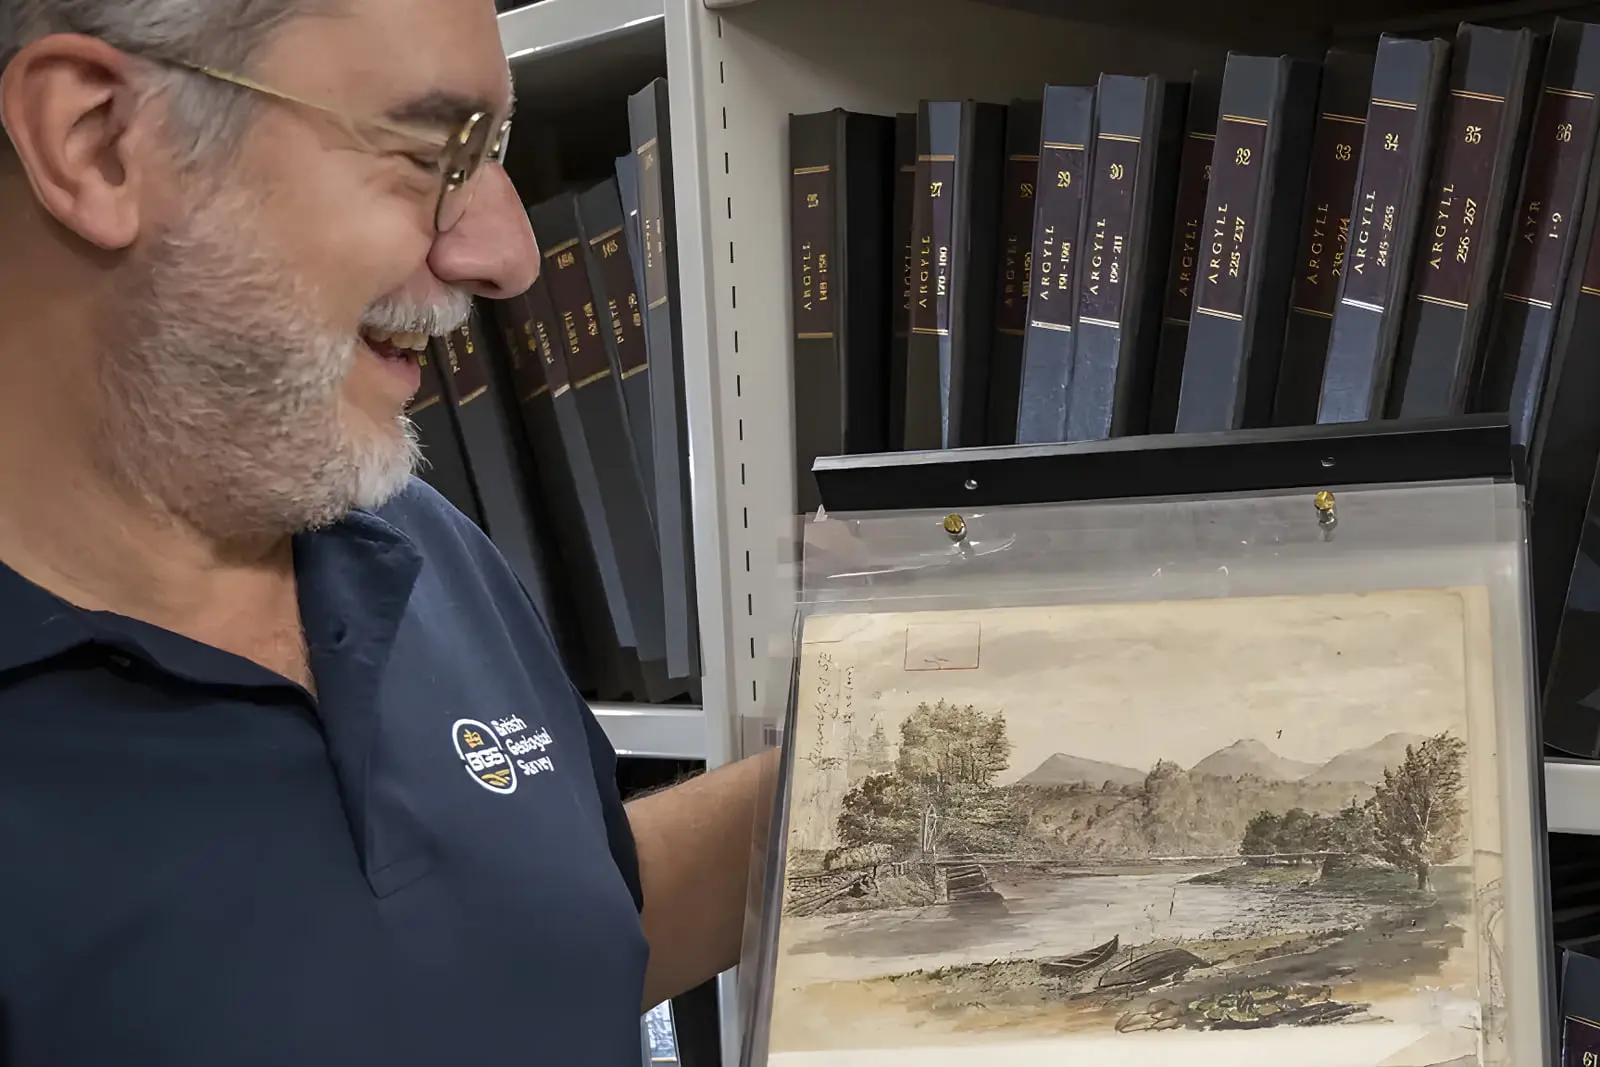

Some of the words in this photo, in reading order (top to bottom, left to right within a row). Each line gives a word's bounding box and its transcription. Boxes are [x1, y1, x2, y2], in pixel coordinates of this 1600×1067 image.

[1236, 147, 1251, 165] 32
[1335, 144, 1351, 161] 33
[1384, 133, 1399, 151] 34
[1464, 125, 1482, 144] 35
[1556, 123, 1572, 142] 36
[1090, 218, 1106, 295] ARGYLL
[1208, 203, 1228, 284] ARGYLL
[1307, 203, 1329, 284] ARGYLL
[1354, 190, 1376, 274] ARGYLL
[1429, 183, 1454, 269] ARGYLL
[1523, 201, 1541, 243] AYR
[802, 241, 812, 311] ARGYLL
[919, 235, 931, 308] ARGYLL
[1005, 235, 1018, 306] ARGYLL
[1040, 225, 1054, 300] ARGYLL
[1179, 219, 1198, 296] ARGYLL
[490, 714, 527, 736] British
[505, 727, 553, 755] Geological
[517, 756, 554, 775] Survey
